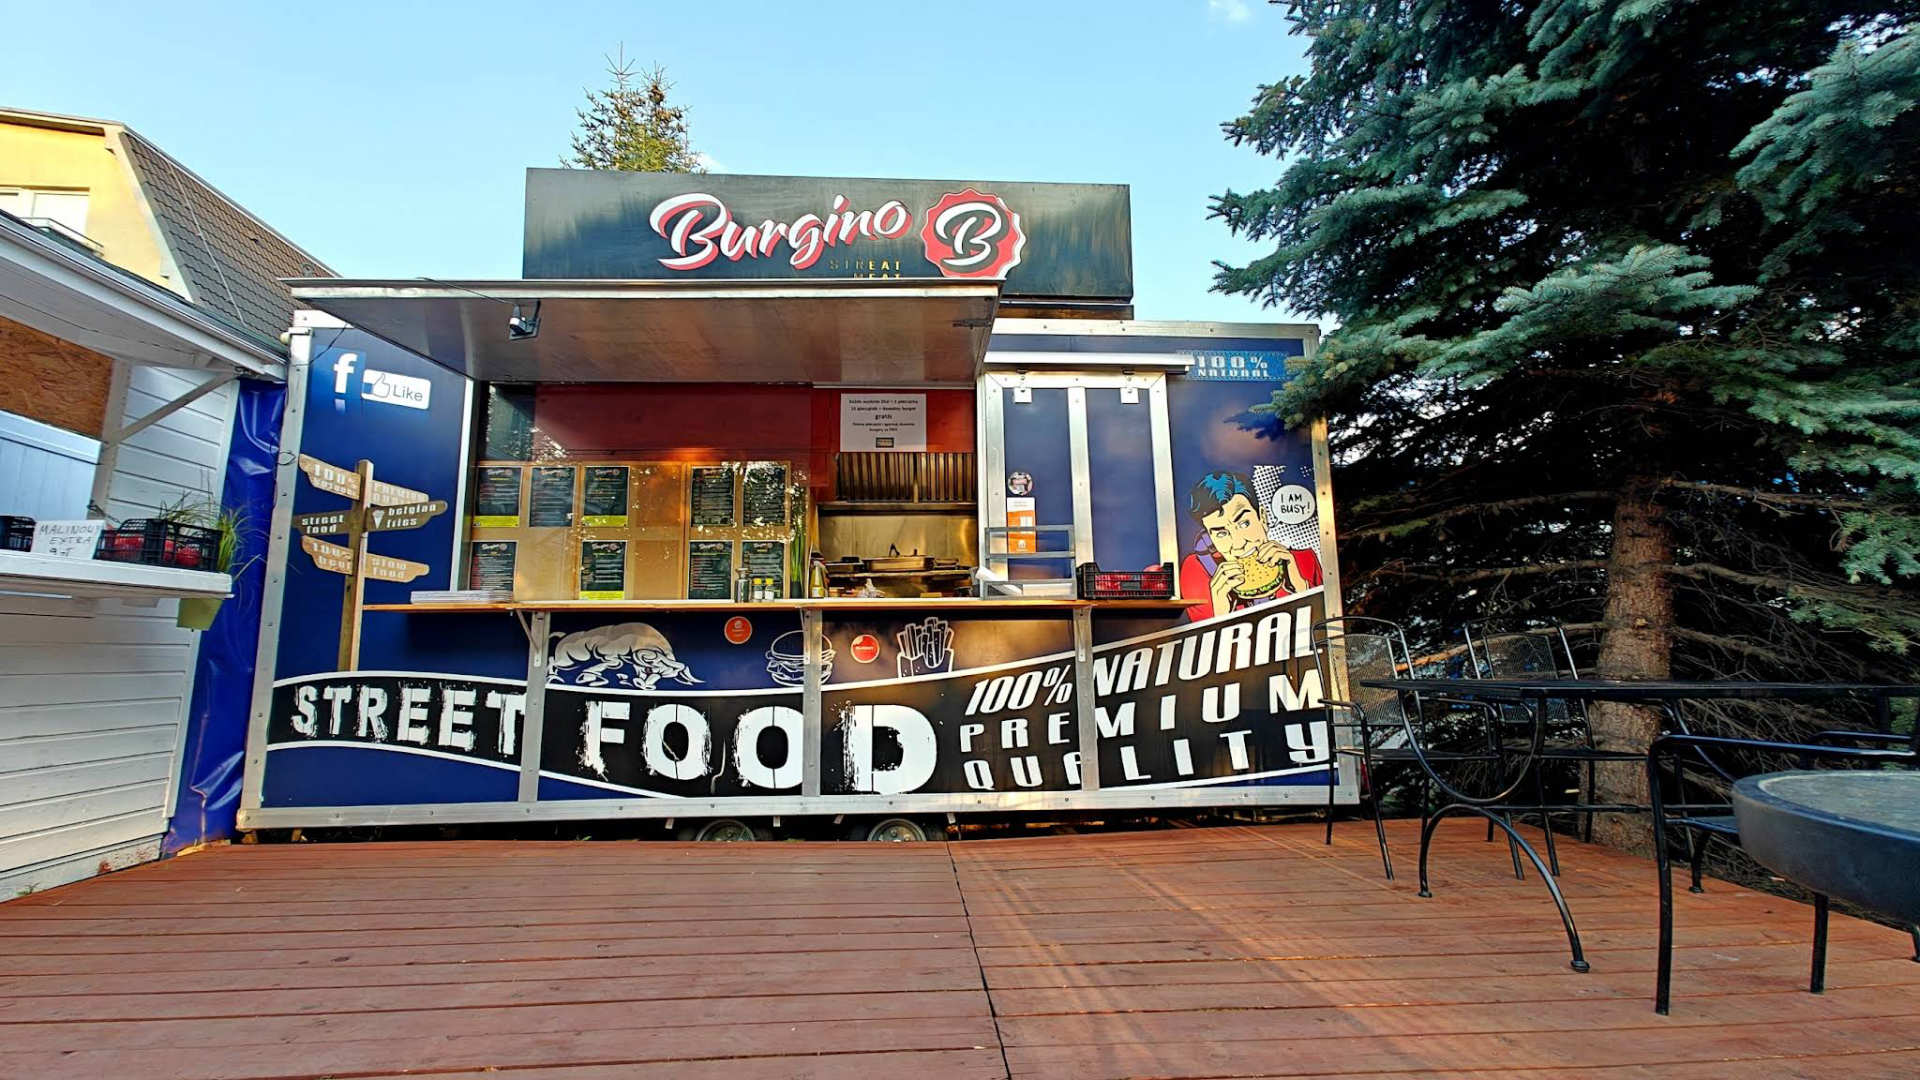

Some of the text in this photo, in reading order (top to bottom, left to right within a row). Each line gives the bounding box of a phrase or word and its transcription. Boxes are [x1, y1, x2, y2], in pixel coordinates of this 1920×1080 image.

[650, 192, 911, 270] Burgino
[934, 202, 1006, 267] B
[1196, 355, 1268, 369] 100%
[1197, 369, 1270, 378] NATURAL
[393, 384, 423, 402] Like
[1280, 493, 1303, 504] I AM
[388, 503, 438, 516] belgian
[1280, 501, 1310, 515] BUSY!
[301, 513, 345, 526] street
[386, 517, 418, 529] fries
[306, 524, 338, 535] food
[50, 535, 92, 545] EXTRA
[371, 557, 407, 571] slow
[371, 567, 406, 579] food
[965, 605, 1324, 715] 100% NATURAL
[959, 669, 1324, 752] PREMIUM
[291, 682, 937, 795] STREET FOOD
